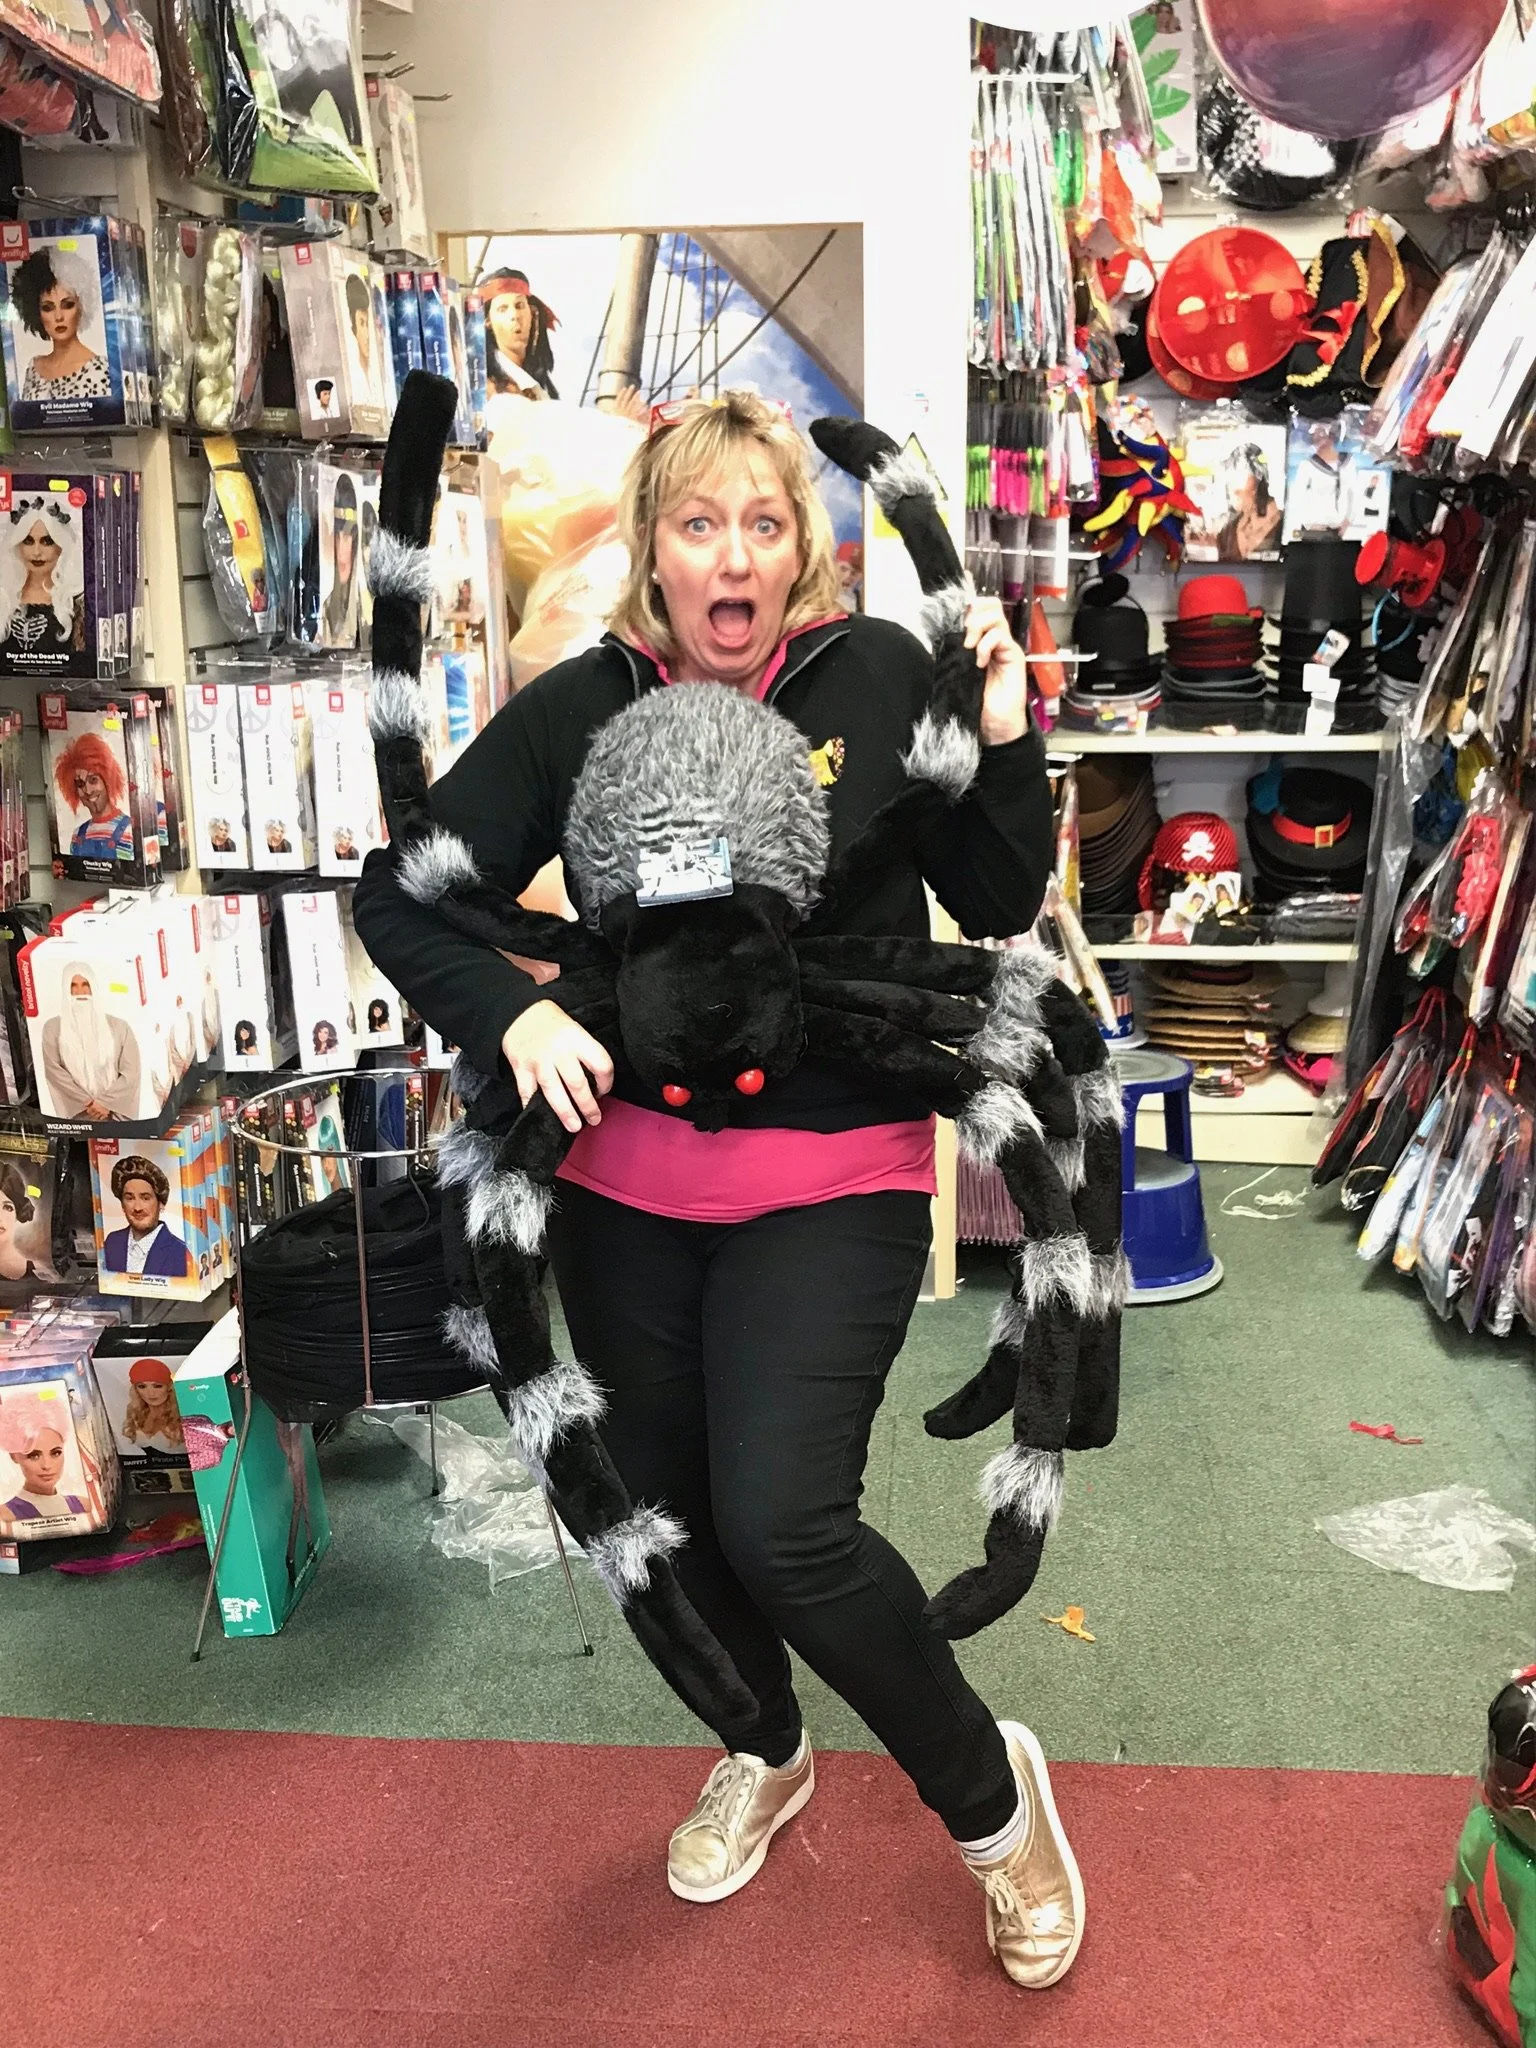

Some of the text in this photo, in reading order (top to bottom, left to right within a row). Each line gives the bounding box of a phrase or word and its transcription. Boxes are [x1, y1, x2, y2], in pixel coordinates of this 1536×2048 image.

[80, 401, 93, 409] Wig
[6, 652, 19, 661] Day
[56, 653, 70, 662] Wig
[101, 861, 113, 869] Wig
[20, 958, 35, 1010] bristol novelty
[94, 1144, 118, 1154] smiffys
